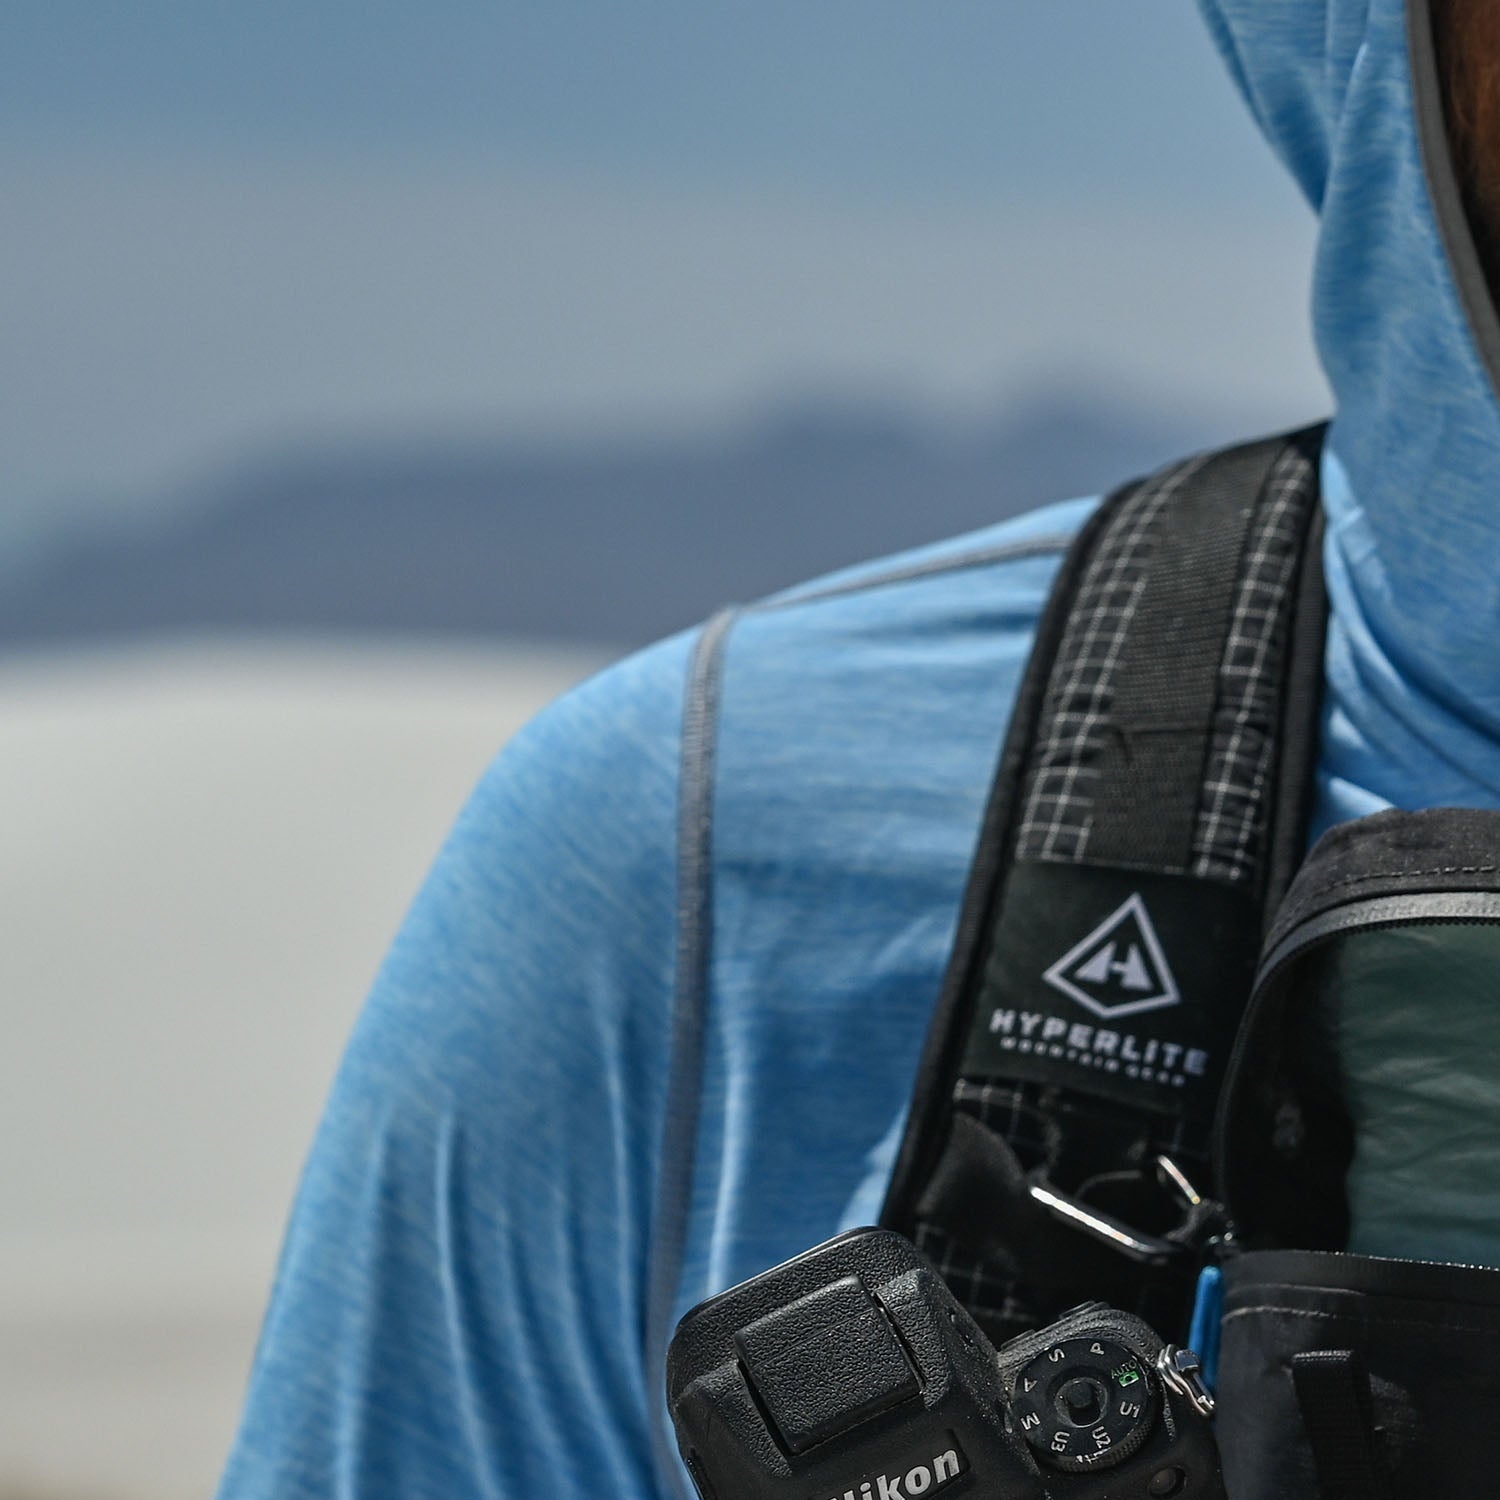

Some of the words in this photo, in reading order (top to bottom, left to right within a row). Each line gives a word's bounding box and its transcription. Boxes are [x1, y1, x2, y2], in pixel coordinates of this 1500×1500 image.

[989, 1008, 1208, 1075] HYPERLITE
[1048, 1348, 1065, 1363] S
[1090, 1342, 1105, 1355] P
[1110, 1358, 1139, 1380] AUTO
[1023, 1377, 1039, 1393] A
[1119, 1401, 1141, 1418] U1
[1020, 1412, 1041, 1431] M
[1051, 1431, 1070, 1452] U3
[1091, 1426, 1112, 1449] U2
